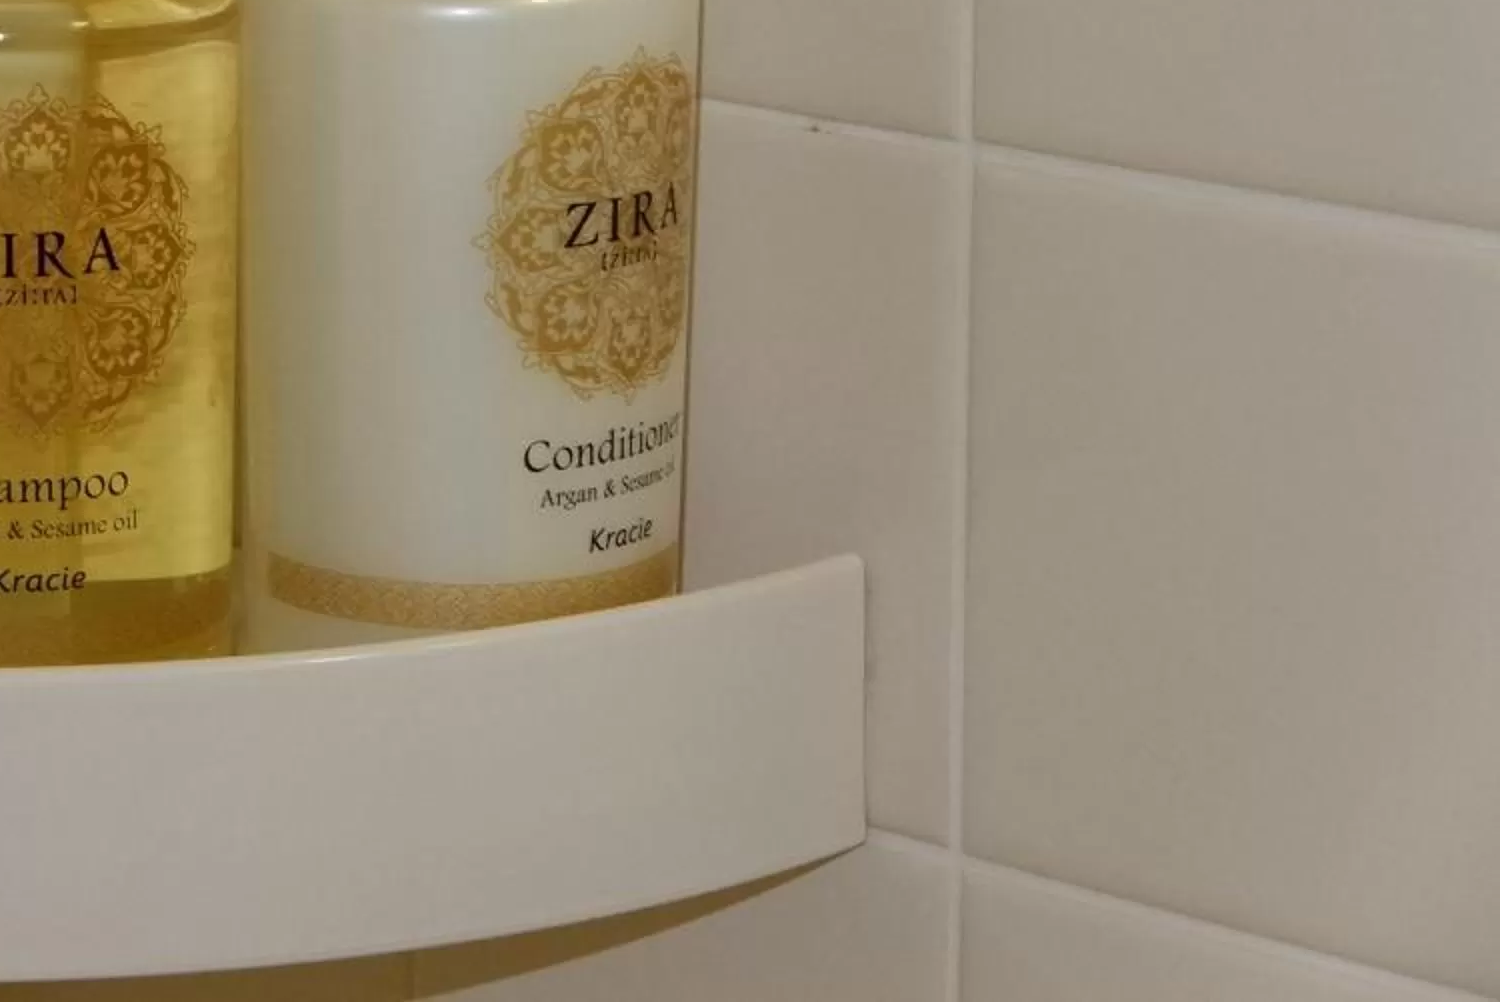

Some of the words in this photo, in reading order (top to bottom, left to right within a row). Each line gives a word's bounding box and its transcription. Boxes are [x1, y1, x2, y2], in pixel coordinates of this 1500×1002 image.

[564, 183, 678, 249] ZIRA
[540, 486, 599, 510] Argan
[603, 478, 617, 498] &
[6, 520, 25, 540] &
[30, 517, 108, 540] Sesame
[113, 509, 139, 532] oil
[588, 516, 654, 554] Kracie
